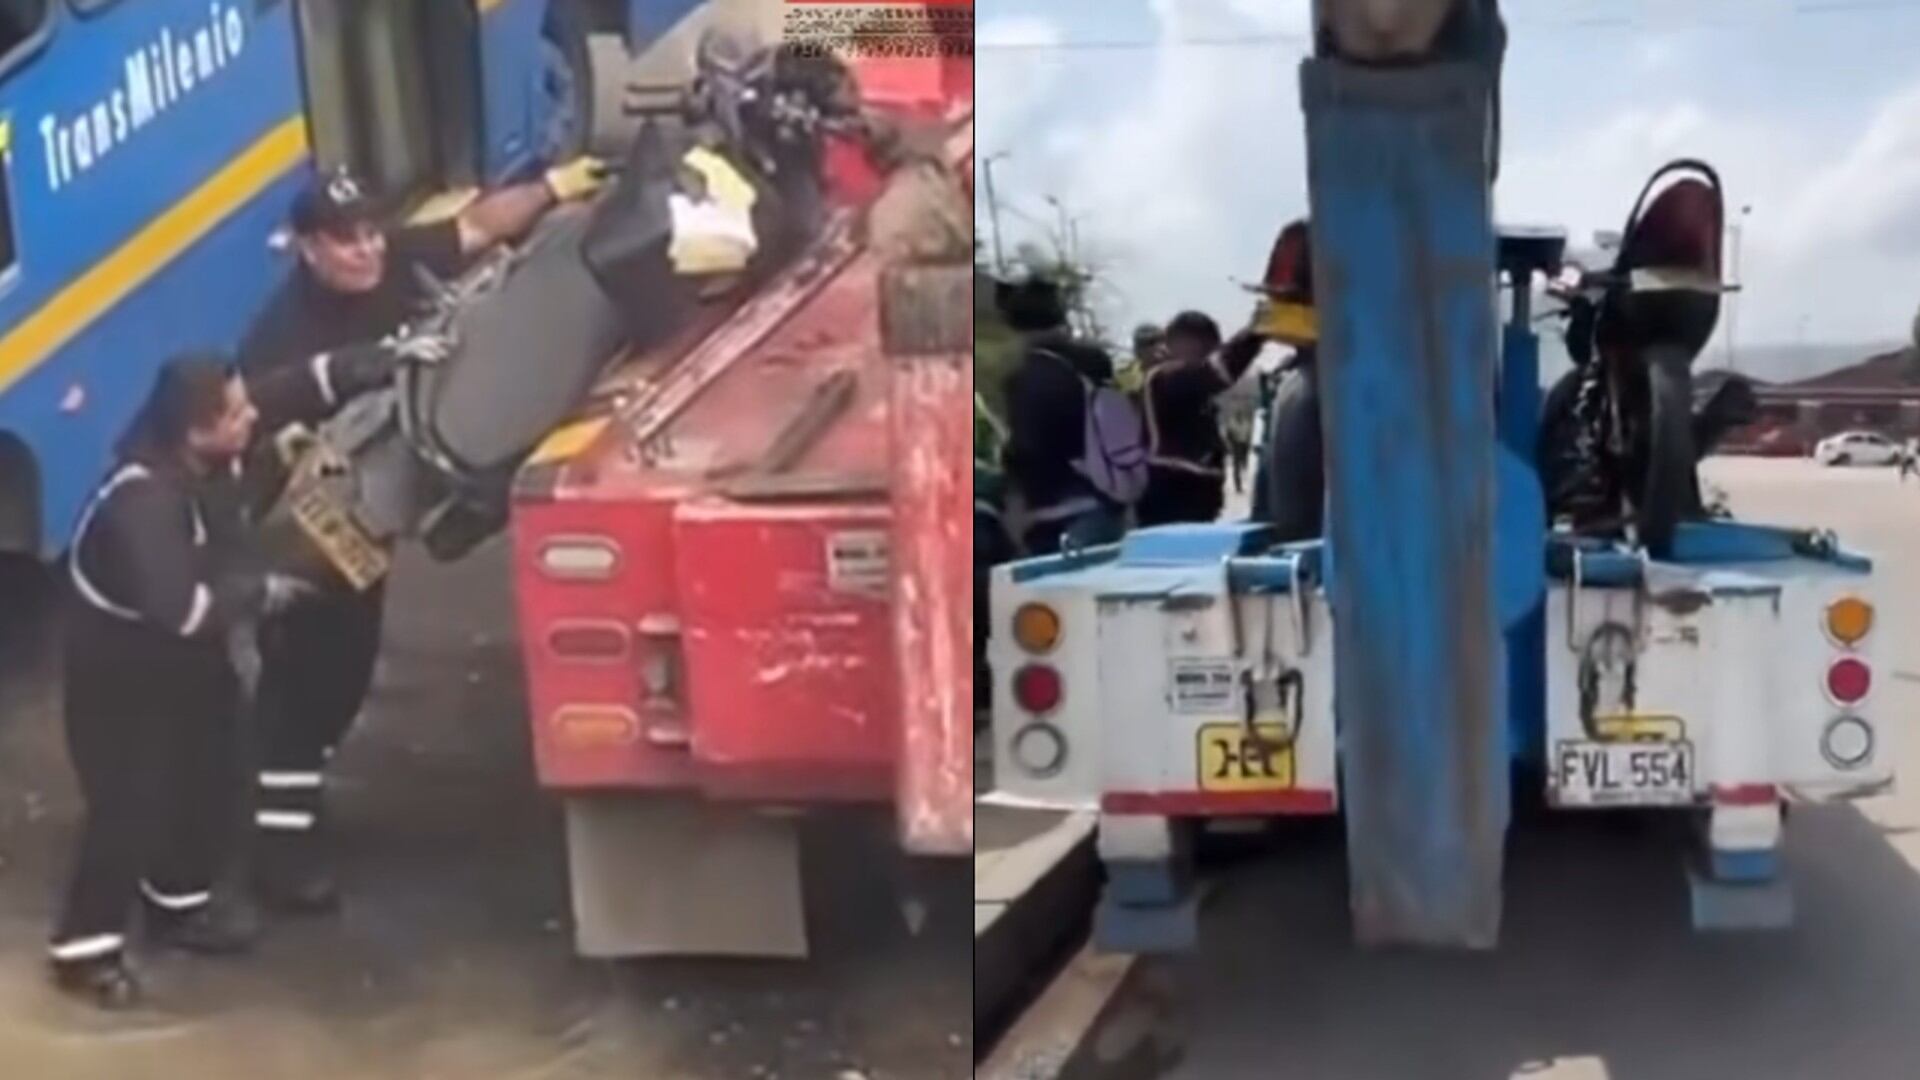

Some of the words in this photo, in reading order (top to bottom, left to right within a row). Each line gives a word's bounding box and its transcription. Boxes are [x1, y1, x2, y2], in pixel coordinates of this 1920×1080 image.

[38, 1, 243, 192] TransMilenio
[1561, 751, 1621, 788] FVL
[1629, 751, 1687, 788] 554
